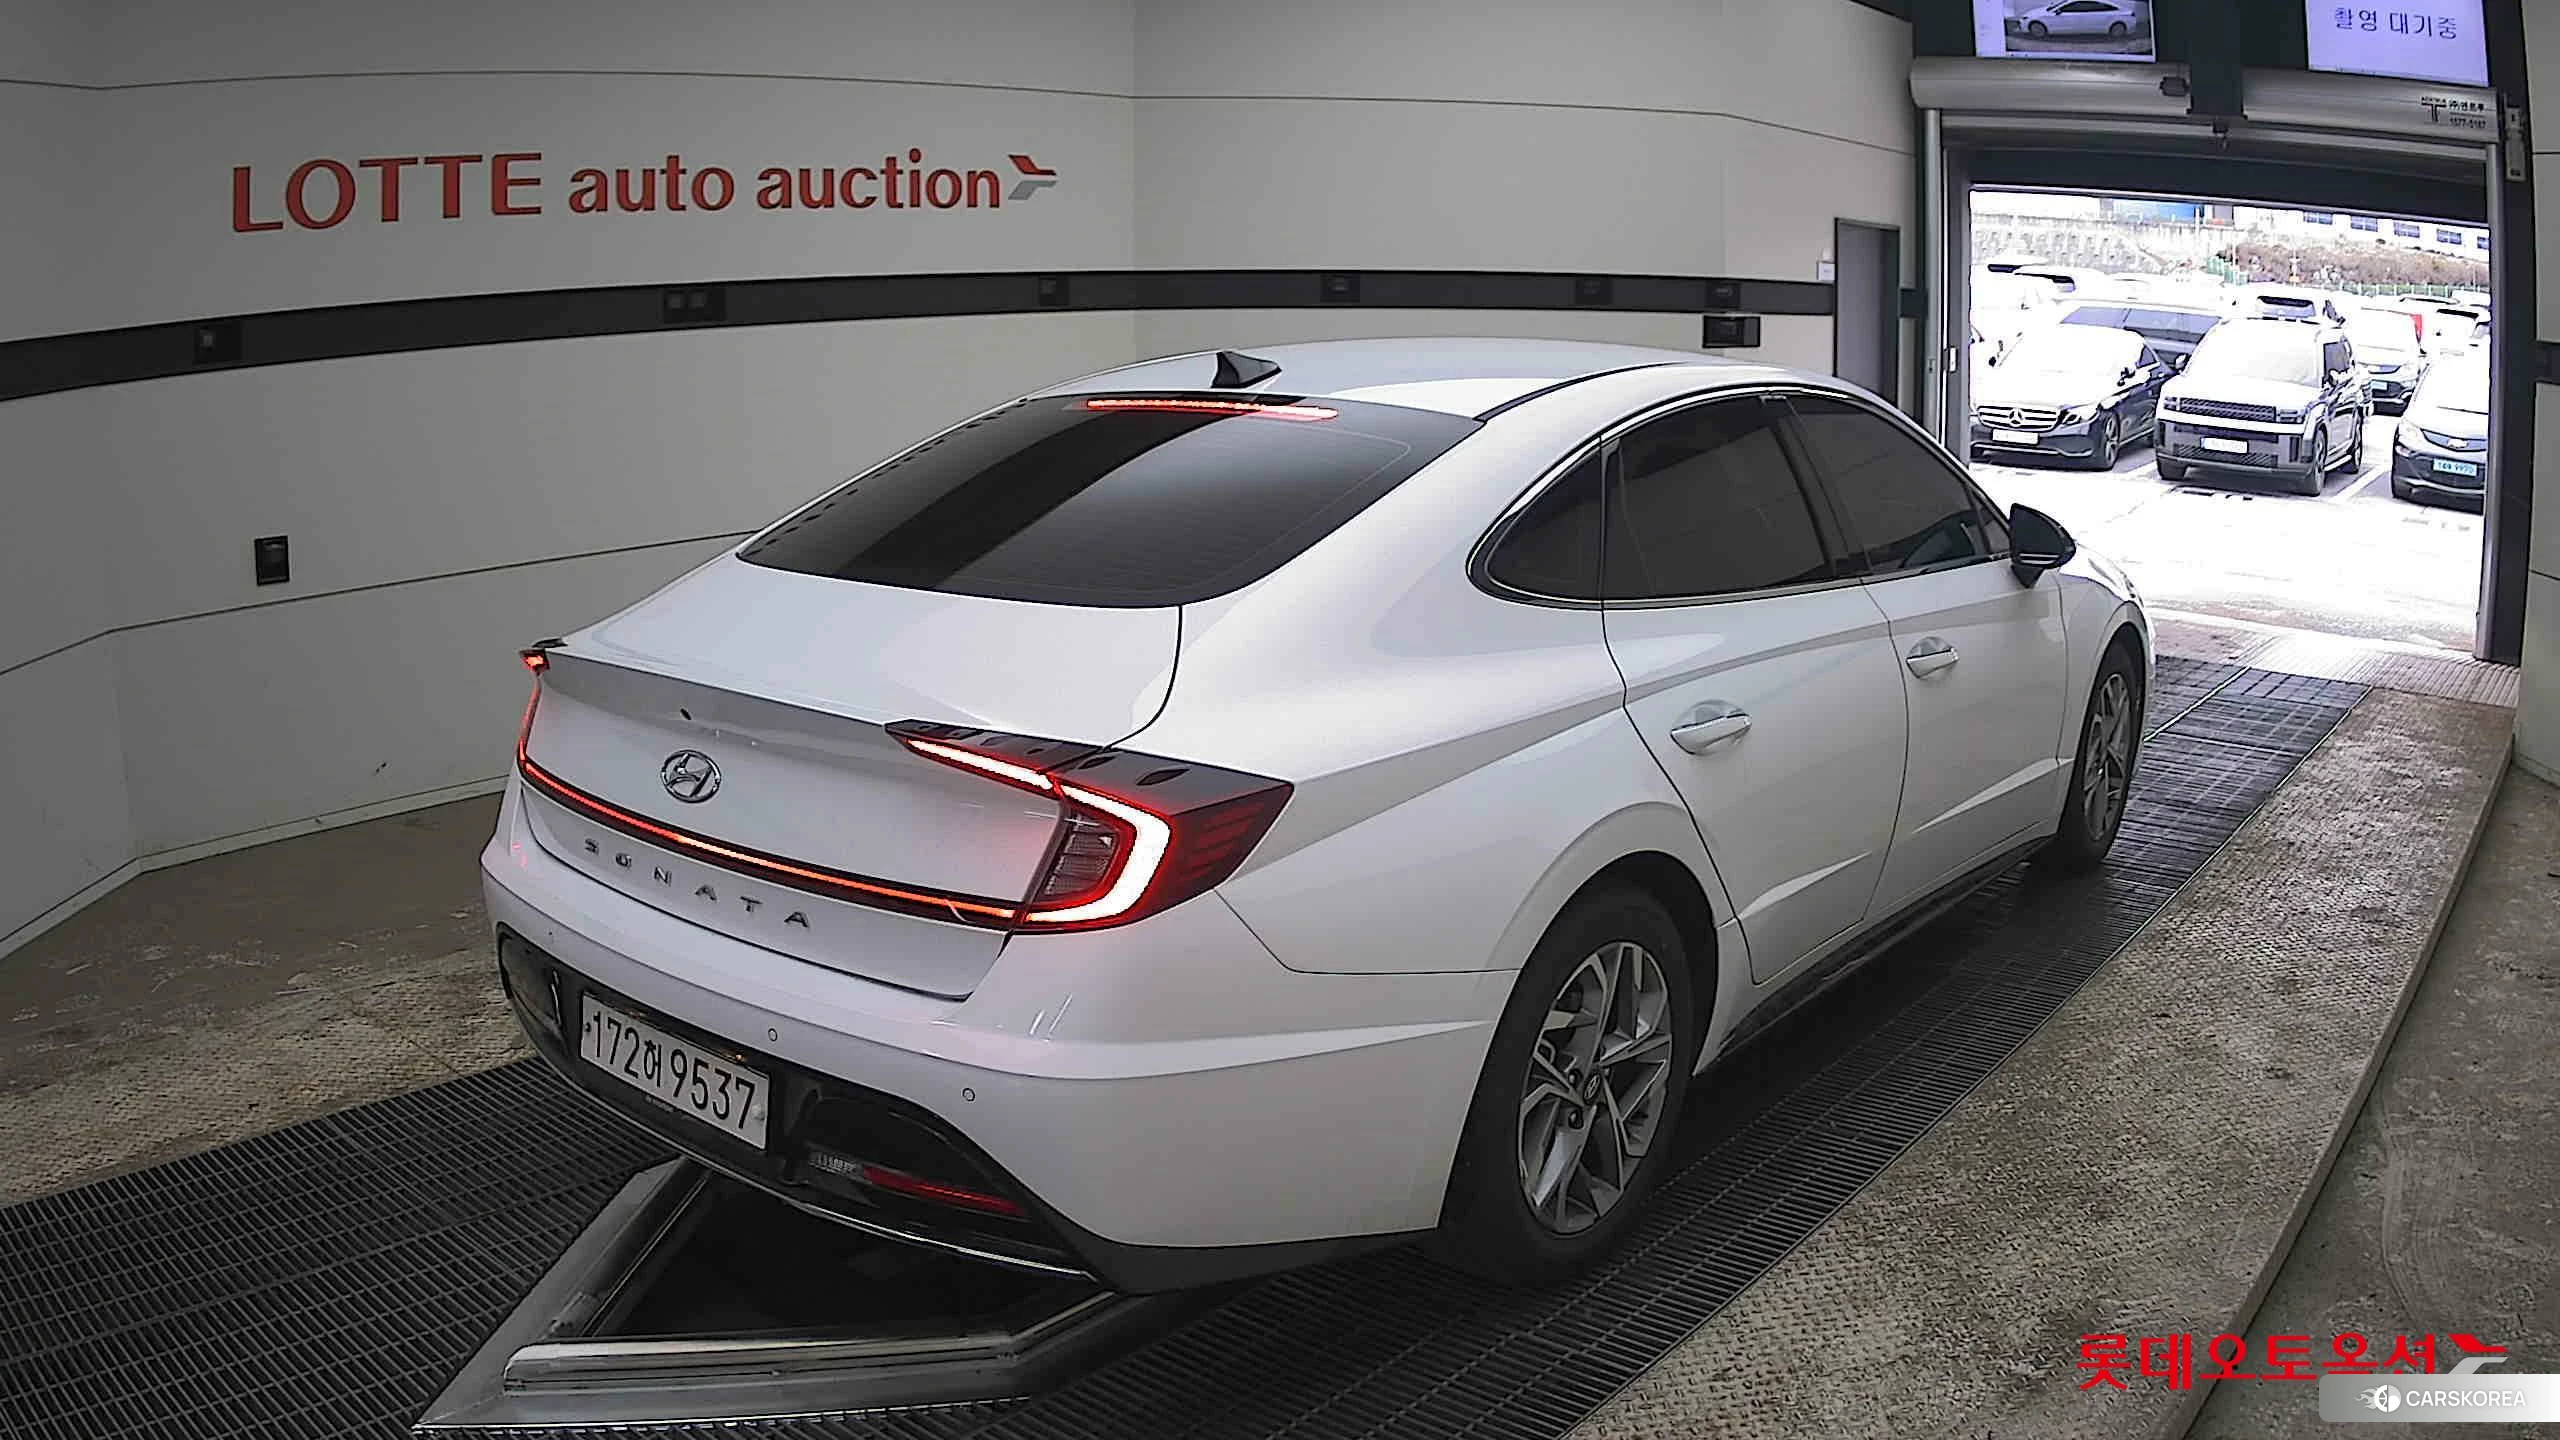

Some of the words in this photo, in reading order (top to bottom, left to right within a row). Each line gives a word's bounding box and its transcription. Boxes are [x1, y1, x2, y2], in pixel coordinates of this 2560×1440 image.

[2388, 12, 2457, 40] 대기중
[232, 152, 542, 233] LOTTE
[568, 154, 735, 214] auto
[756, 147, 1001, 210] auction
[584, 837, 811, 929] SONATA
